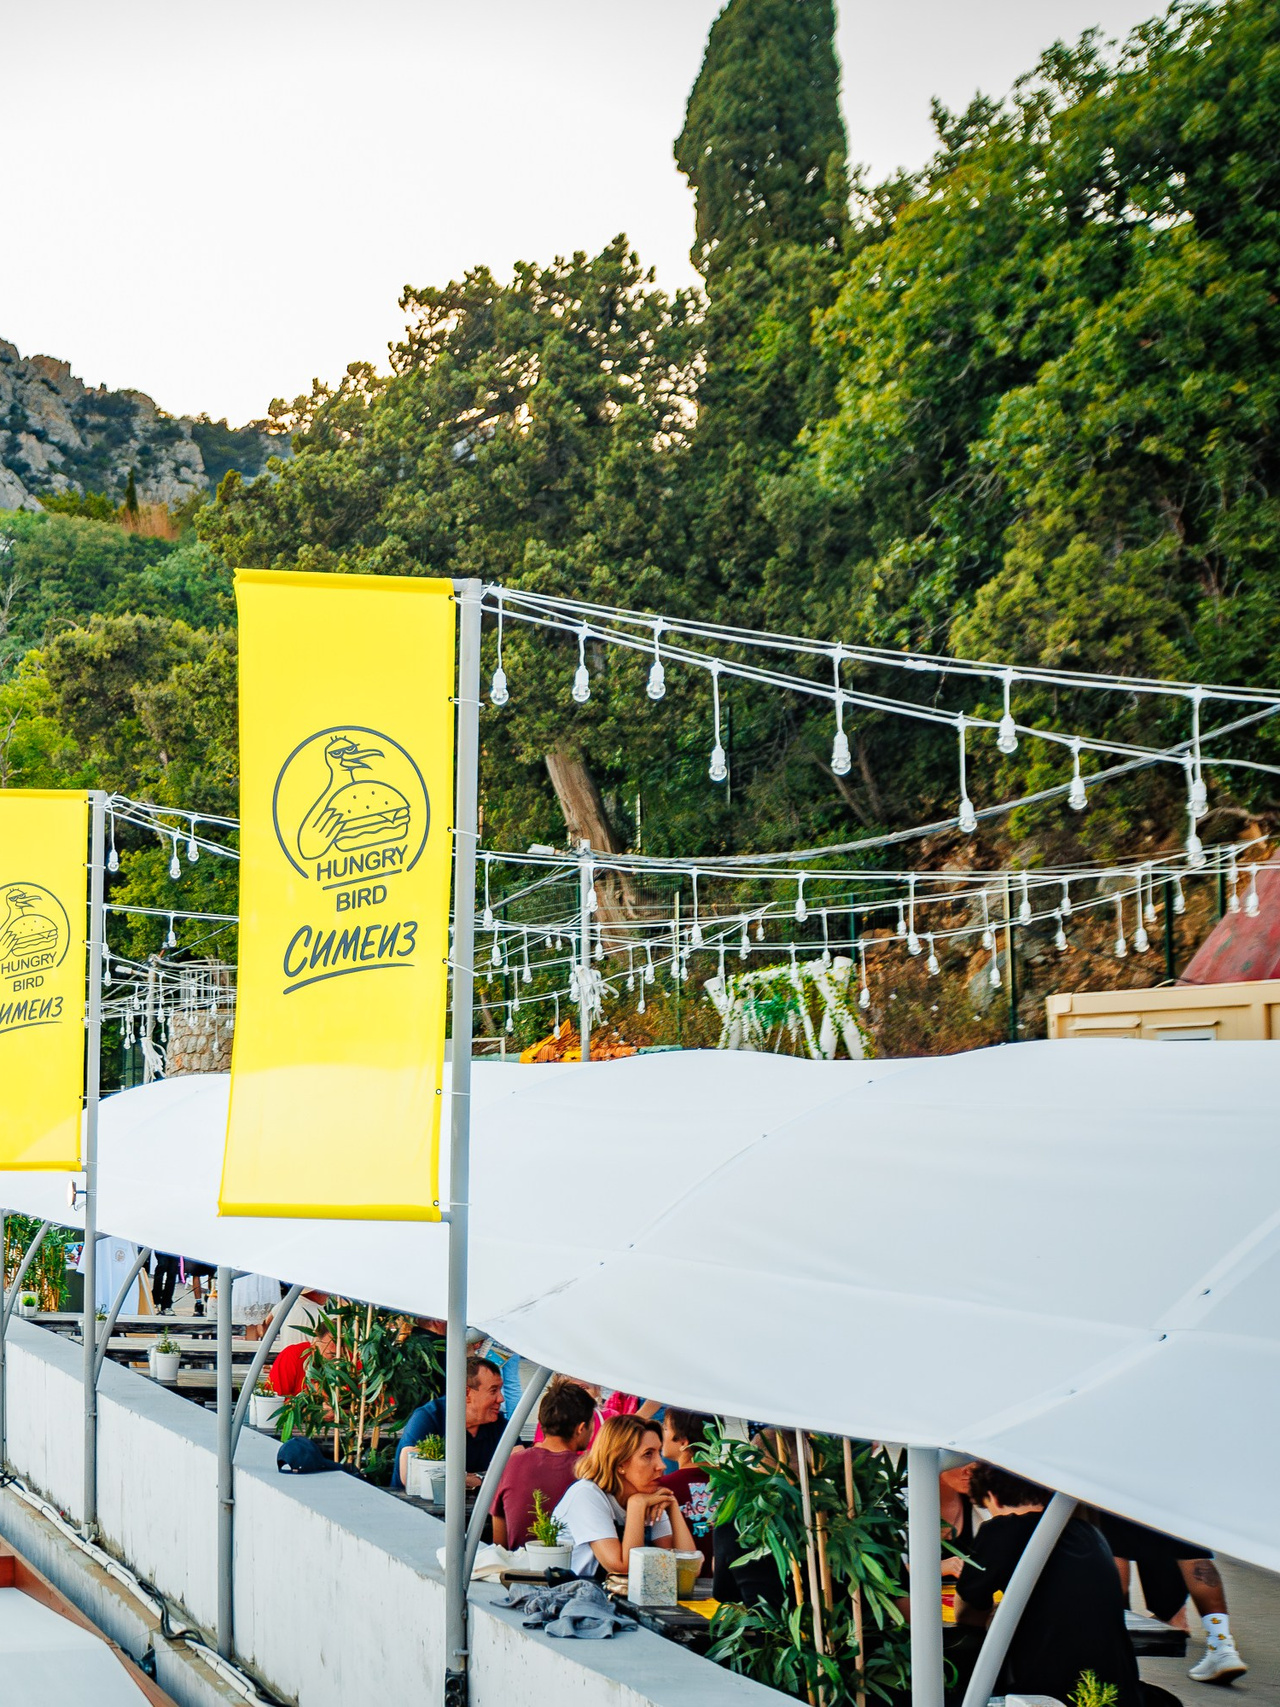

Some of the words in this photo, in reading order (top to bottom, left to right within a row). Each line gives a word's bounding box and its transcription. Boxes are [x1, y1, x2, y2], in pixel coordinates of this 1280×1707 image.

[317, 844, 408, 881] HUNGRY
[336, 885, 387, 912] BIRD
[1, 951, 57, 974] HUNGRY
[283, 921, 418, 977] СИМЕИЗ
[13, 975, 44, 992] BIRD
